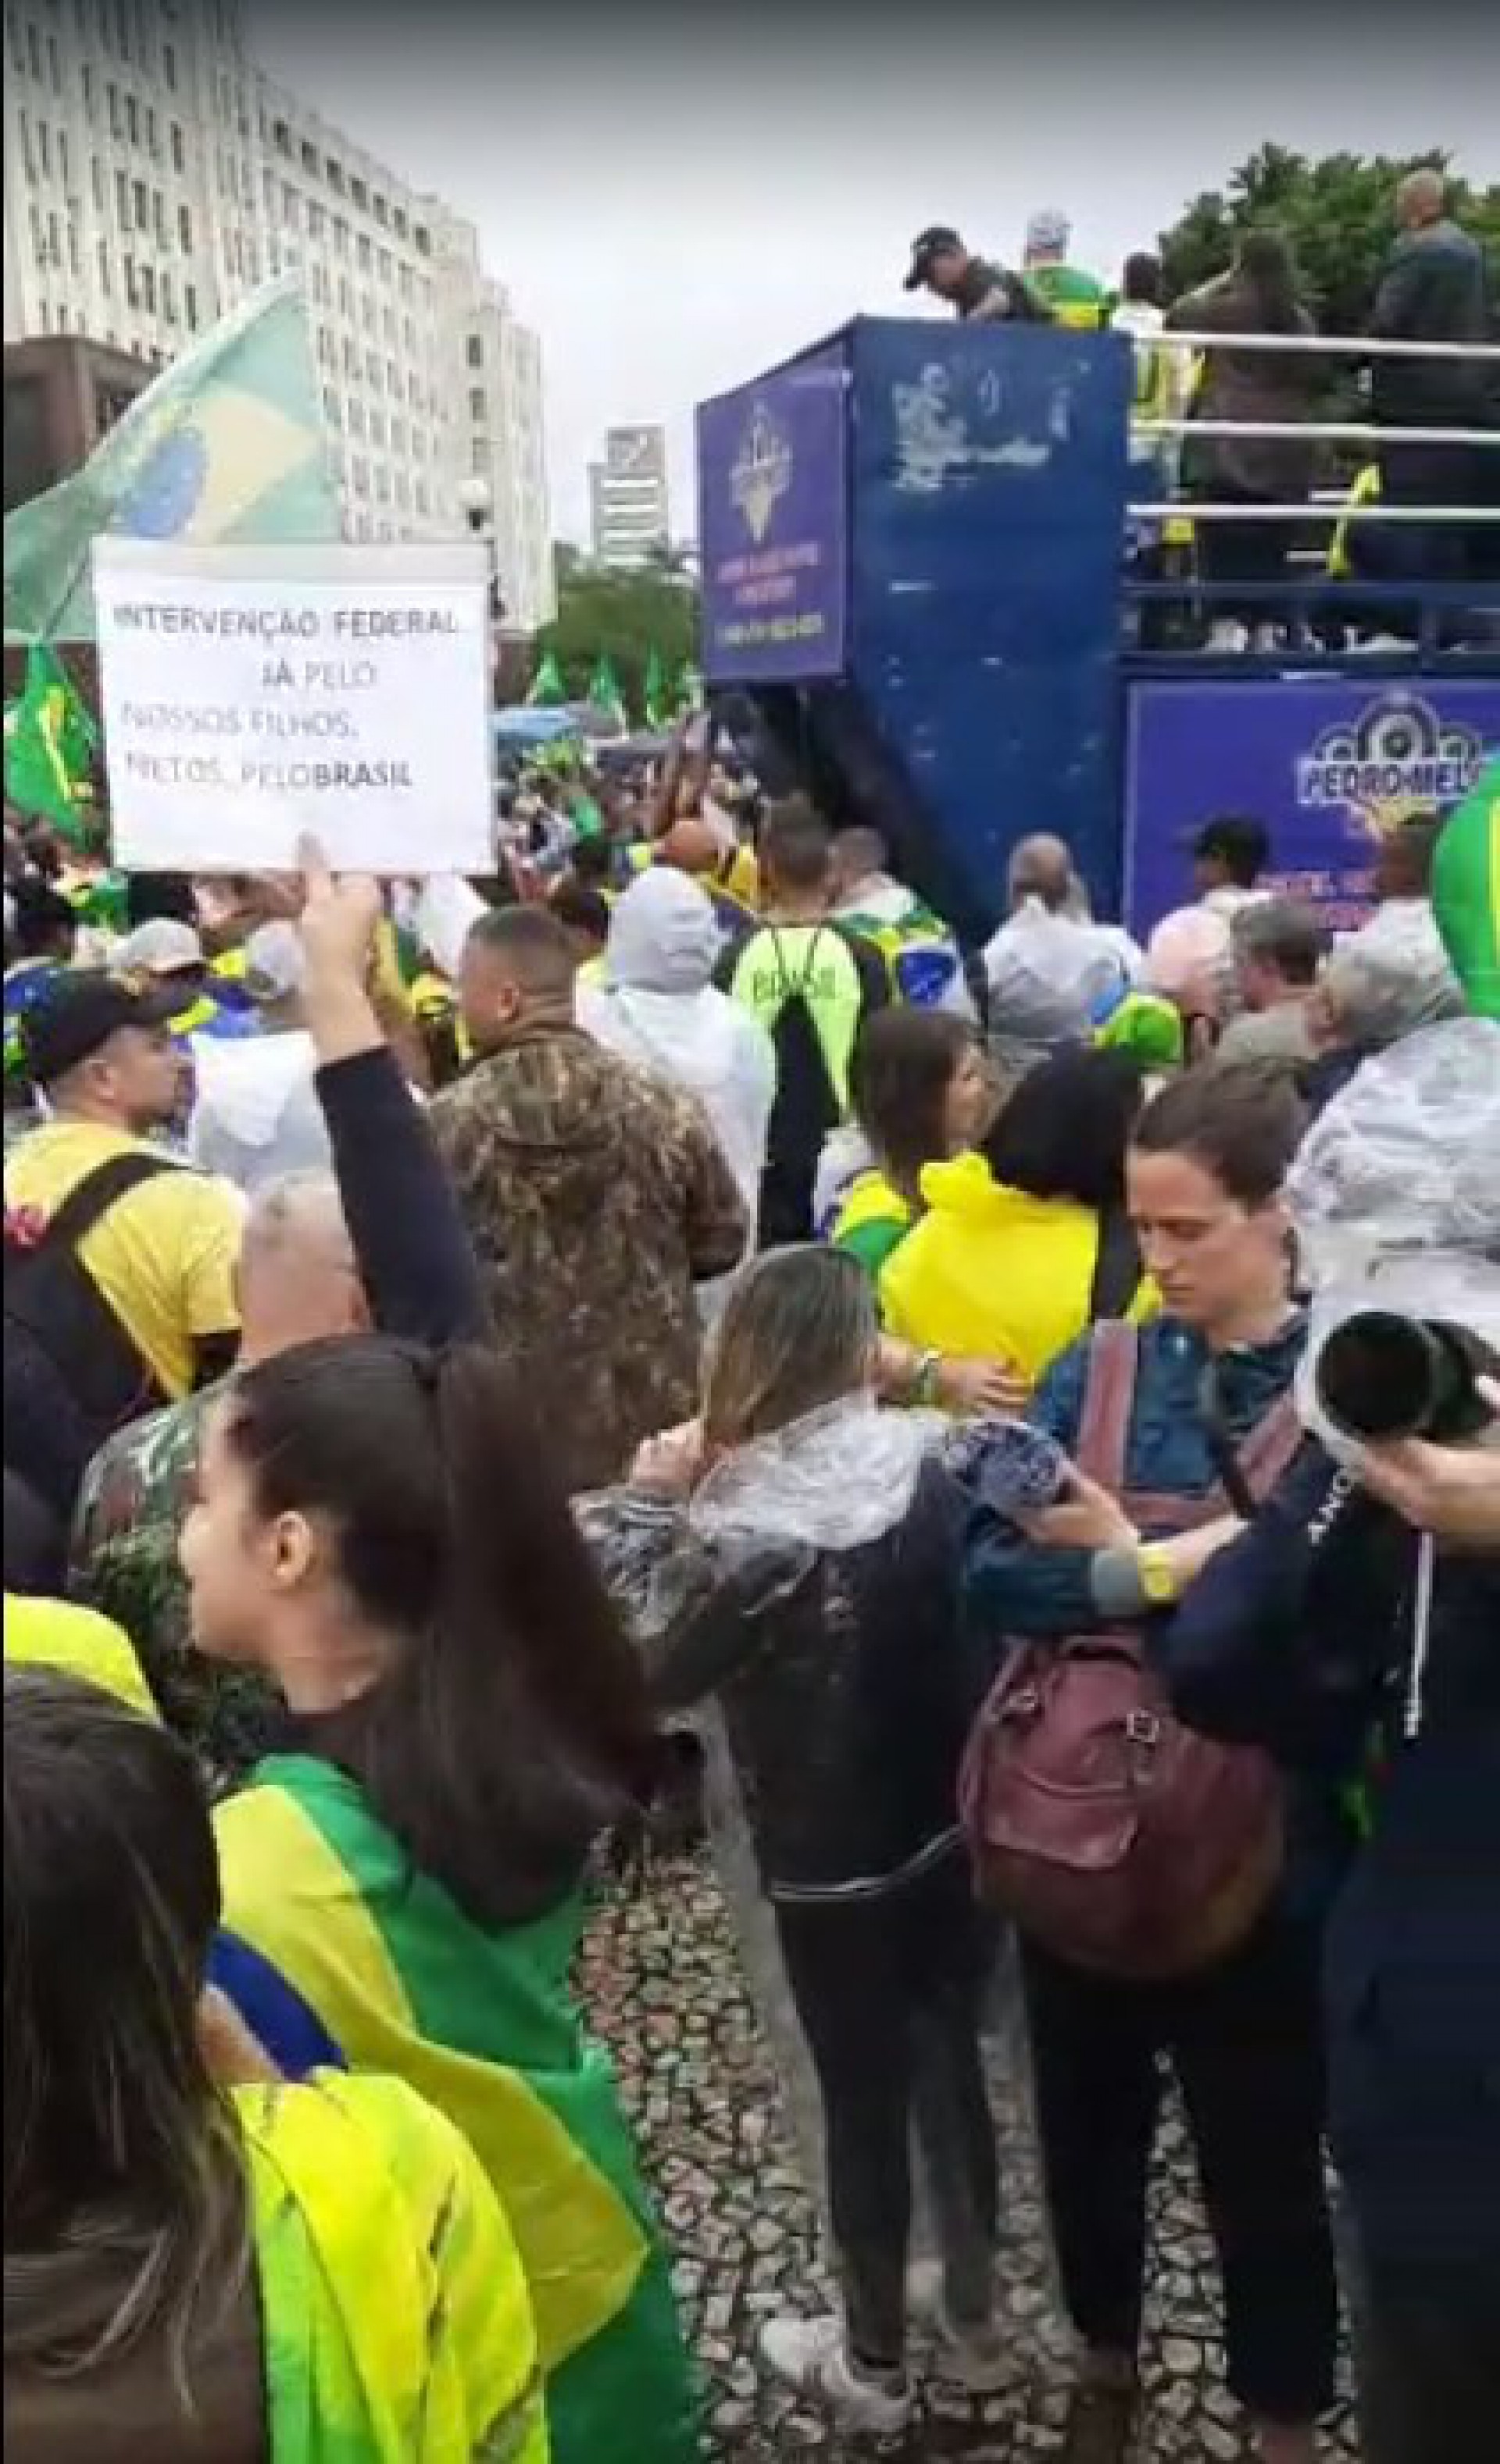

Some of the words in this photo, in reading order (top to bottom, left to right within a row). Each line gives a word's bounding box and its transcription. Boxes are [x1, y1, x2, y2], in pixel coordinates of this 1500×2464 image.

[333, 607, 458, 638] FEDERAL
[304, 660, 379, 691] PELO
[120, 700, 242, 735] NOSSOS
